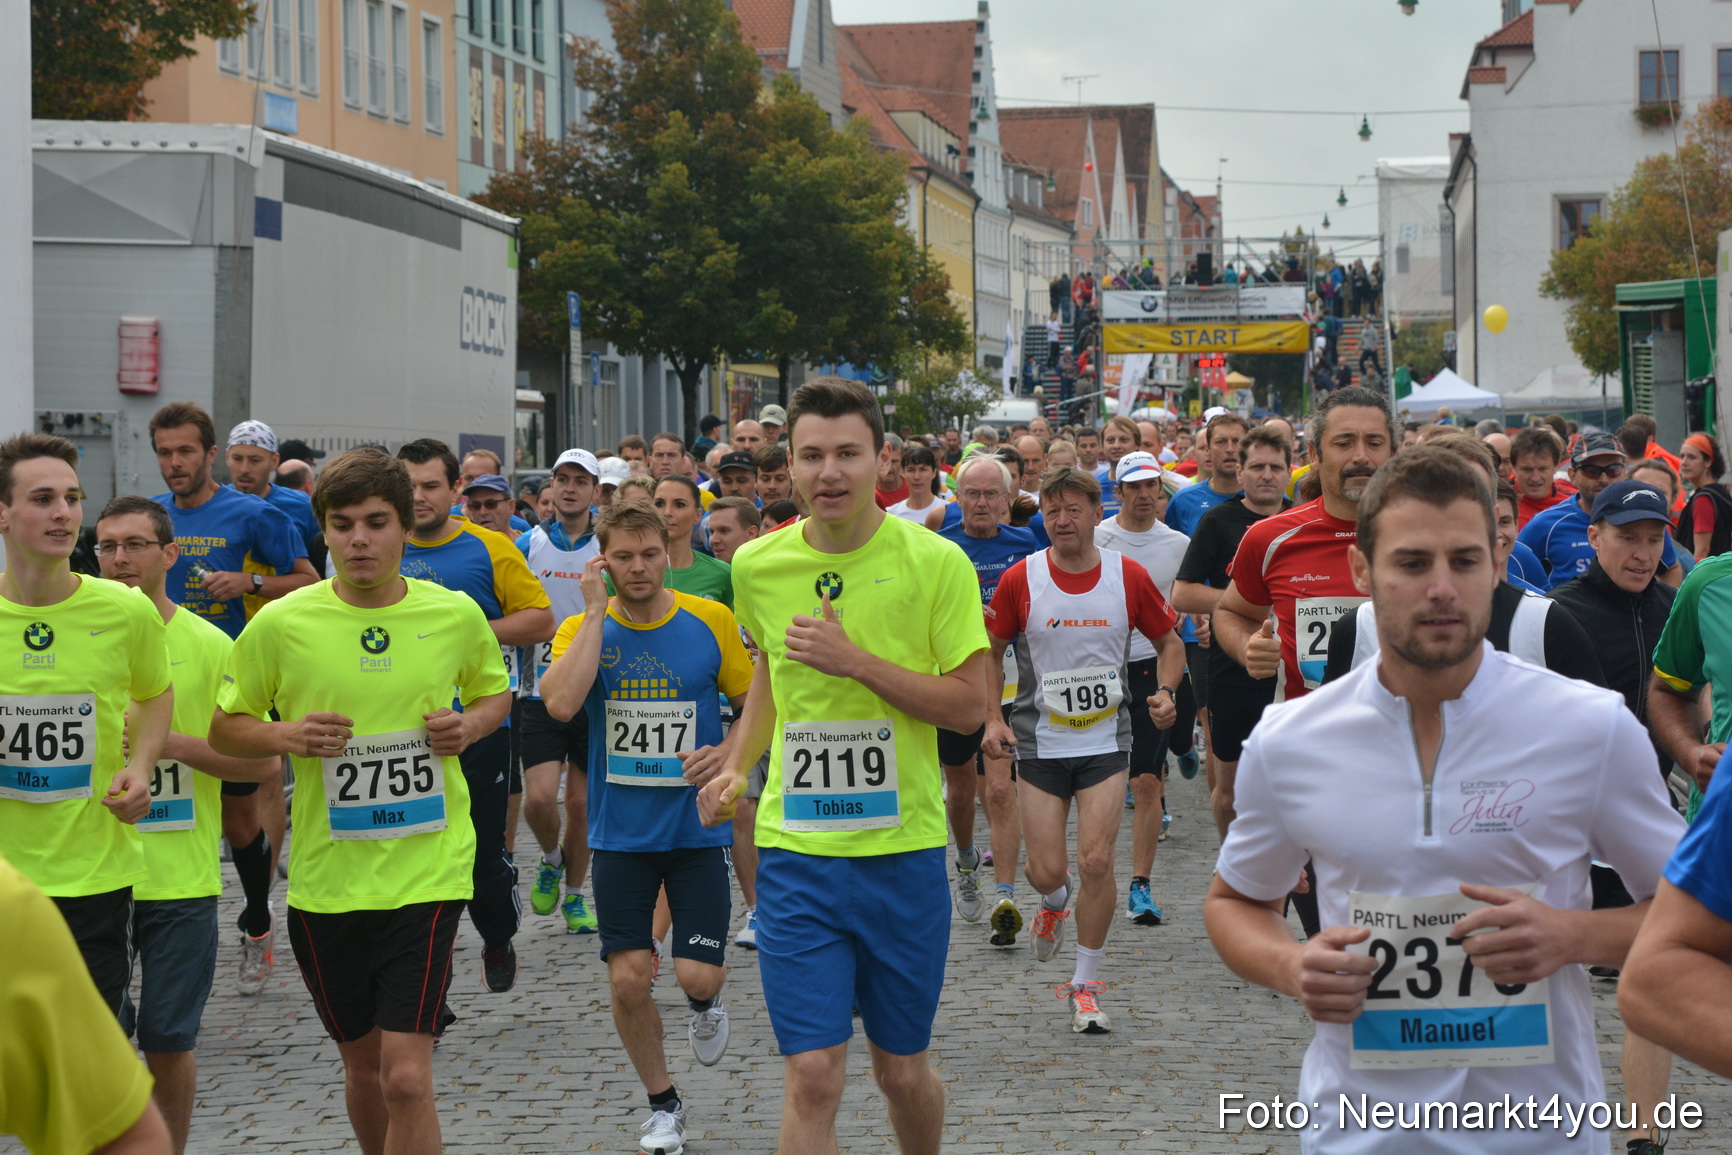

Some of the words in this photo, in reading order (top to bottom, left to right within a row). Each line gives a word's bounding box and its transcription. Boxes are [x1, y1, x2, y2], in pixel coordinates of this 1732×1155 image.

[461, 286, 506, 357] BOCK
[1170, 328, 1241, 346] START
[1298, 606, 1332, 616] PARTL
[1063, 619, 1112, 627] KLEBL
[23, 653, 55, 664] Partl
[360, 656, 392, 667] Partl
[1043, 677, 1070, 687] PARTL
[1071, 673, 1107, 683] Neumarkt
[1060, 684, 1109, 712] 198
[16, 705, 74, 716] Neumarkt
[608, 708, 634, 718] PARTL
[637, 710, 680, 718] Neumarkt
[1069, 716, 1099, 728] Rainer
[614, 721, 687, 753] 2417
[785, 732, 817, 742] PARTL
[820, 731, 873, 742] Neumarkt
[366, 739, 422, 755] Neumarkt
[635, 761, 662, 775] Rudi
[793, 746, 886, 788] 2119
[17, 771, 50, 788] Max
[336, 753, 434, 802] 2755
[813, 800, 864, 816] Tobias
[1449, 779, 1535, 835] Julia
[372, 809, 406, 825] Max
[1353, 909, 1408, 930] PARTL
[699, 937, 720, 949] asics
[1366, 937, 1528, 999] 237
[1400, 1016, 1496, 1044] Manuel
